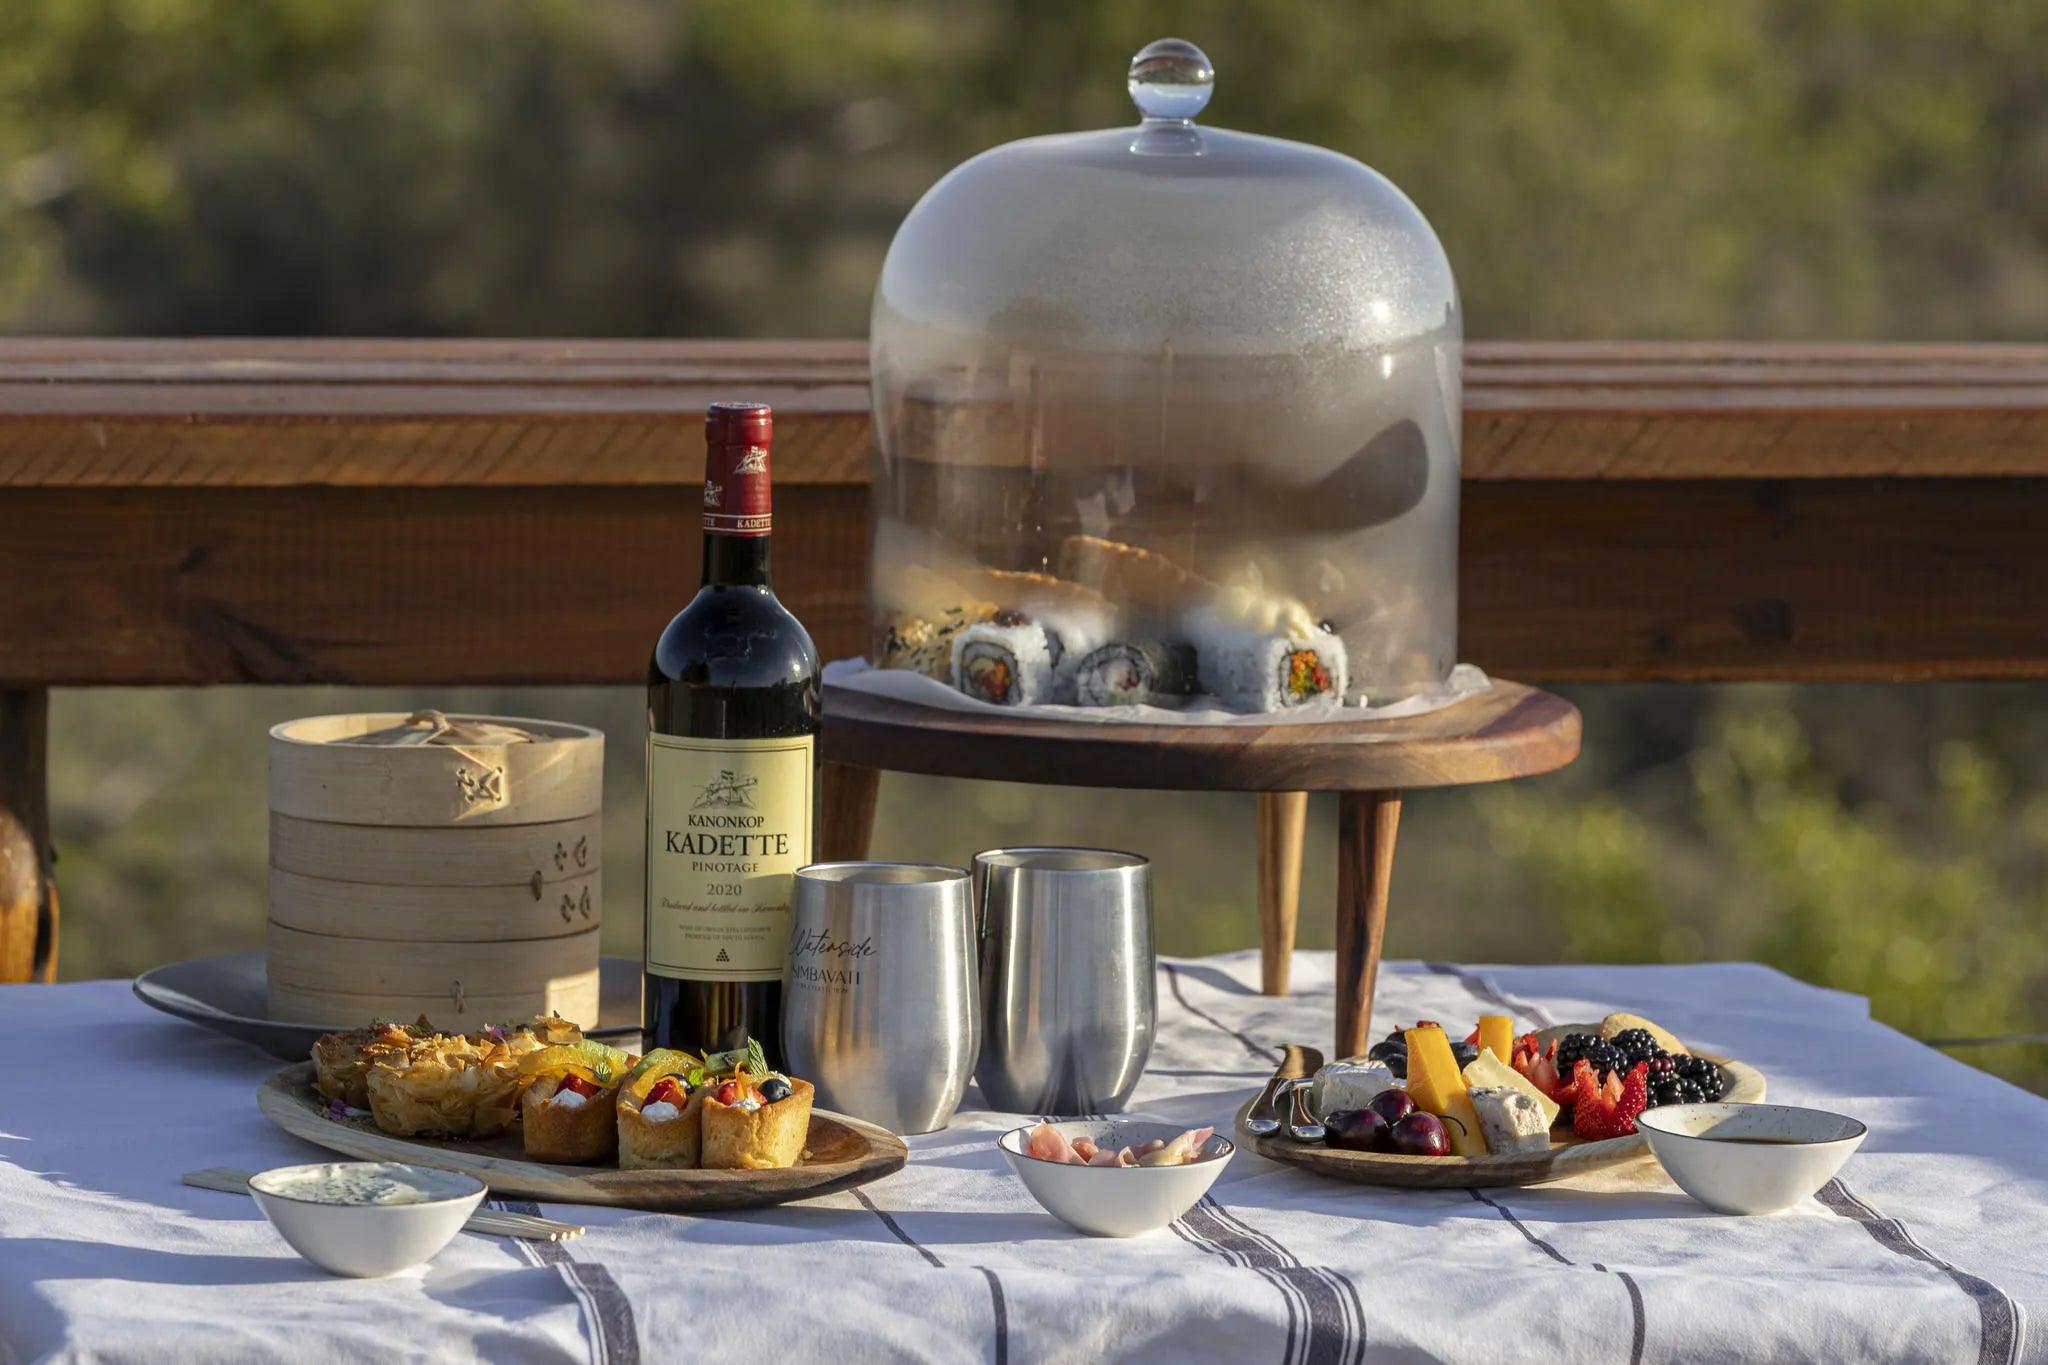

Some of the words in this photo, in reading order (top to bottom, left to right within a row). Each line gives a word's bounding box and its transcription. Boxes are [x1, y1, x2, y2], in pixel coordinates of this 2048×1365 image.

[688, 814, 765, 828] KANONKOP
[665, 830, 789, 856] KADETTE
[692, 861, 759, 873] PINOTAGE
[706, 883, 742, 896] 2020
[693, 902, 708, 912] and
[709, 902, 736, 913] bottled
